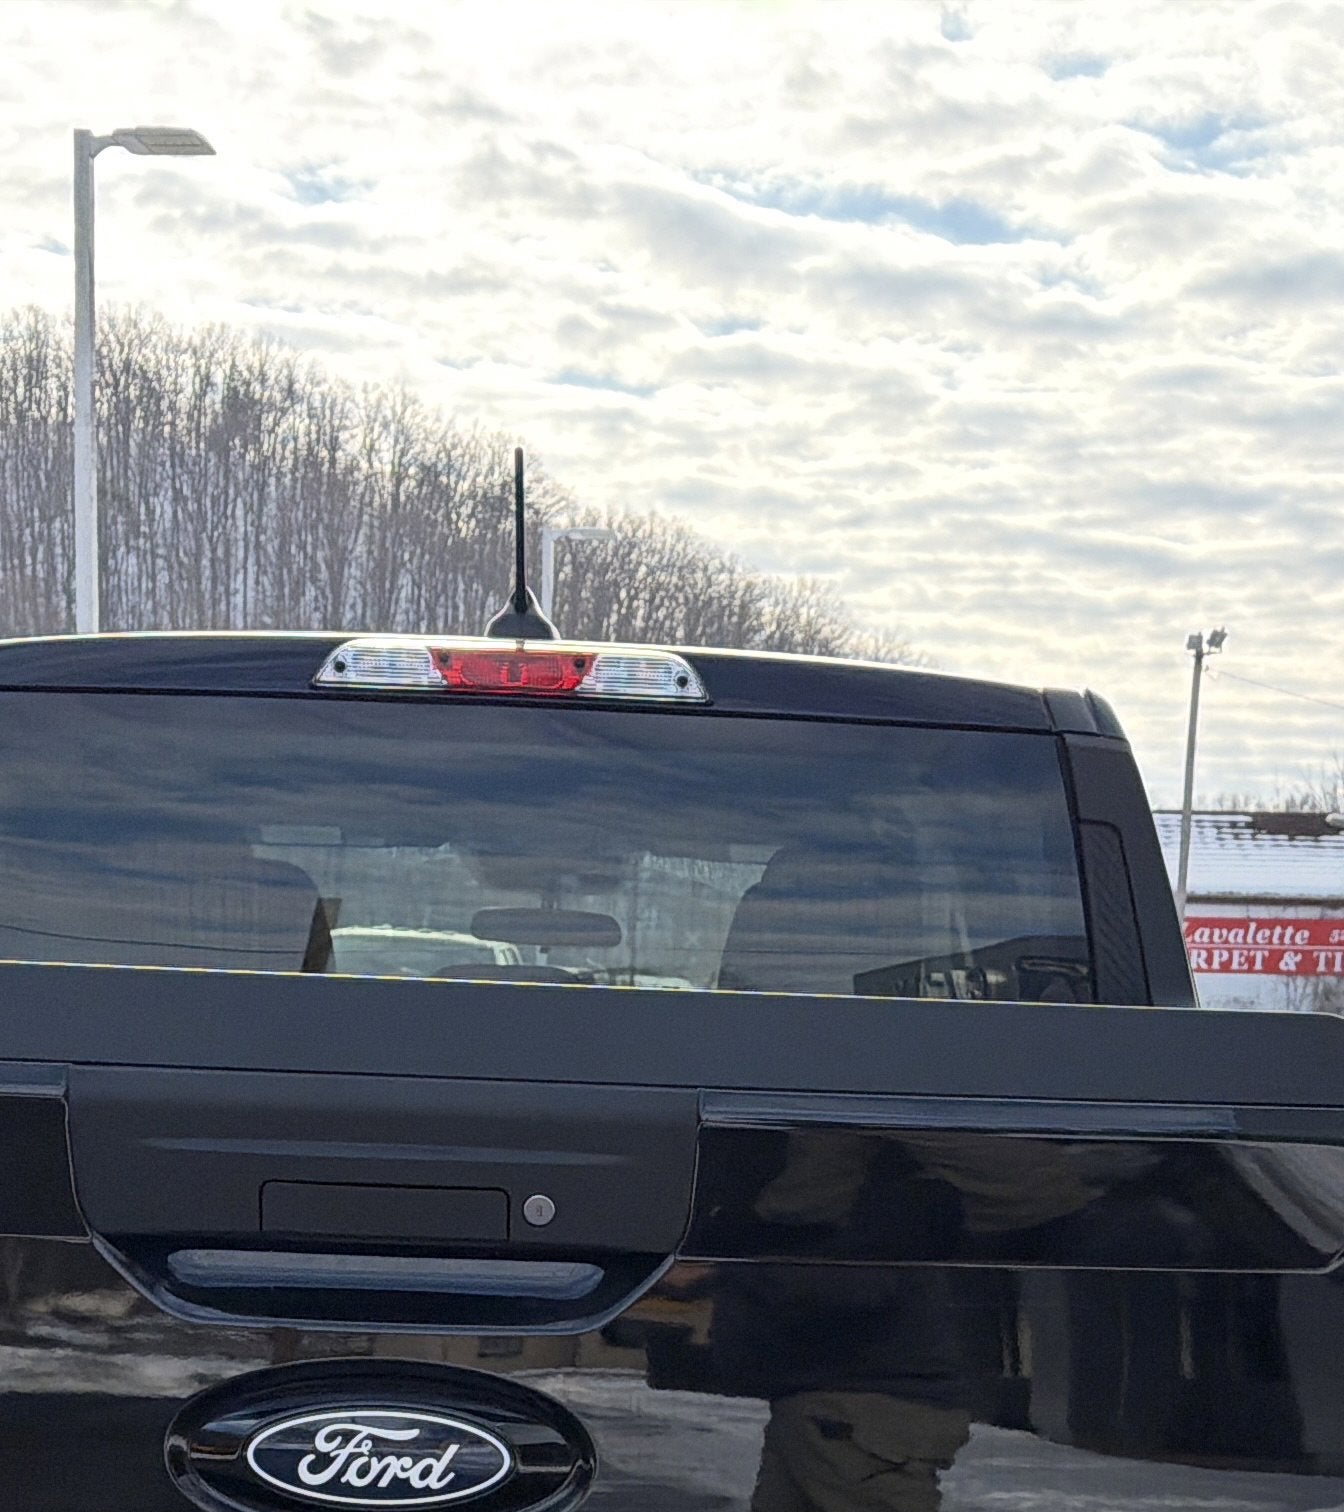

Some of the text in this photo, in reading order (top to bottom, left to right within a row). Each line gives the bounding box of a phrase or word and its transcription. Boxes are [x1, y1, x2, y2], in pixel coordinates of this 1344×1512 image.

[1183, 921, 1310, 945] Lavalette
[1189, 949, 1270, 971] RPET
[1278, 951, 1303, 972] &
[298, 1423, 459, 1490] Ford
